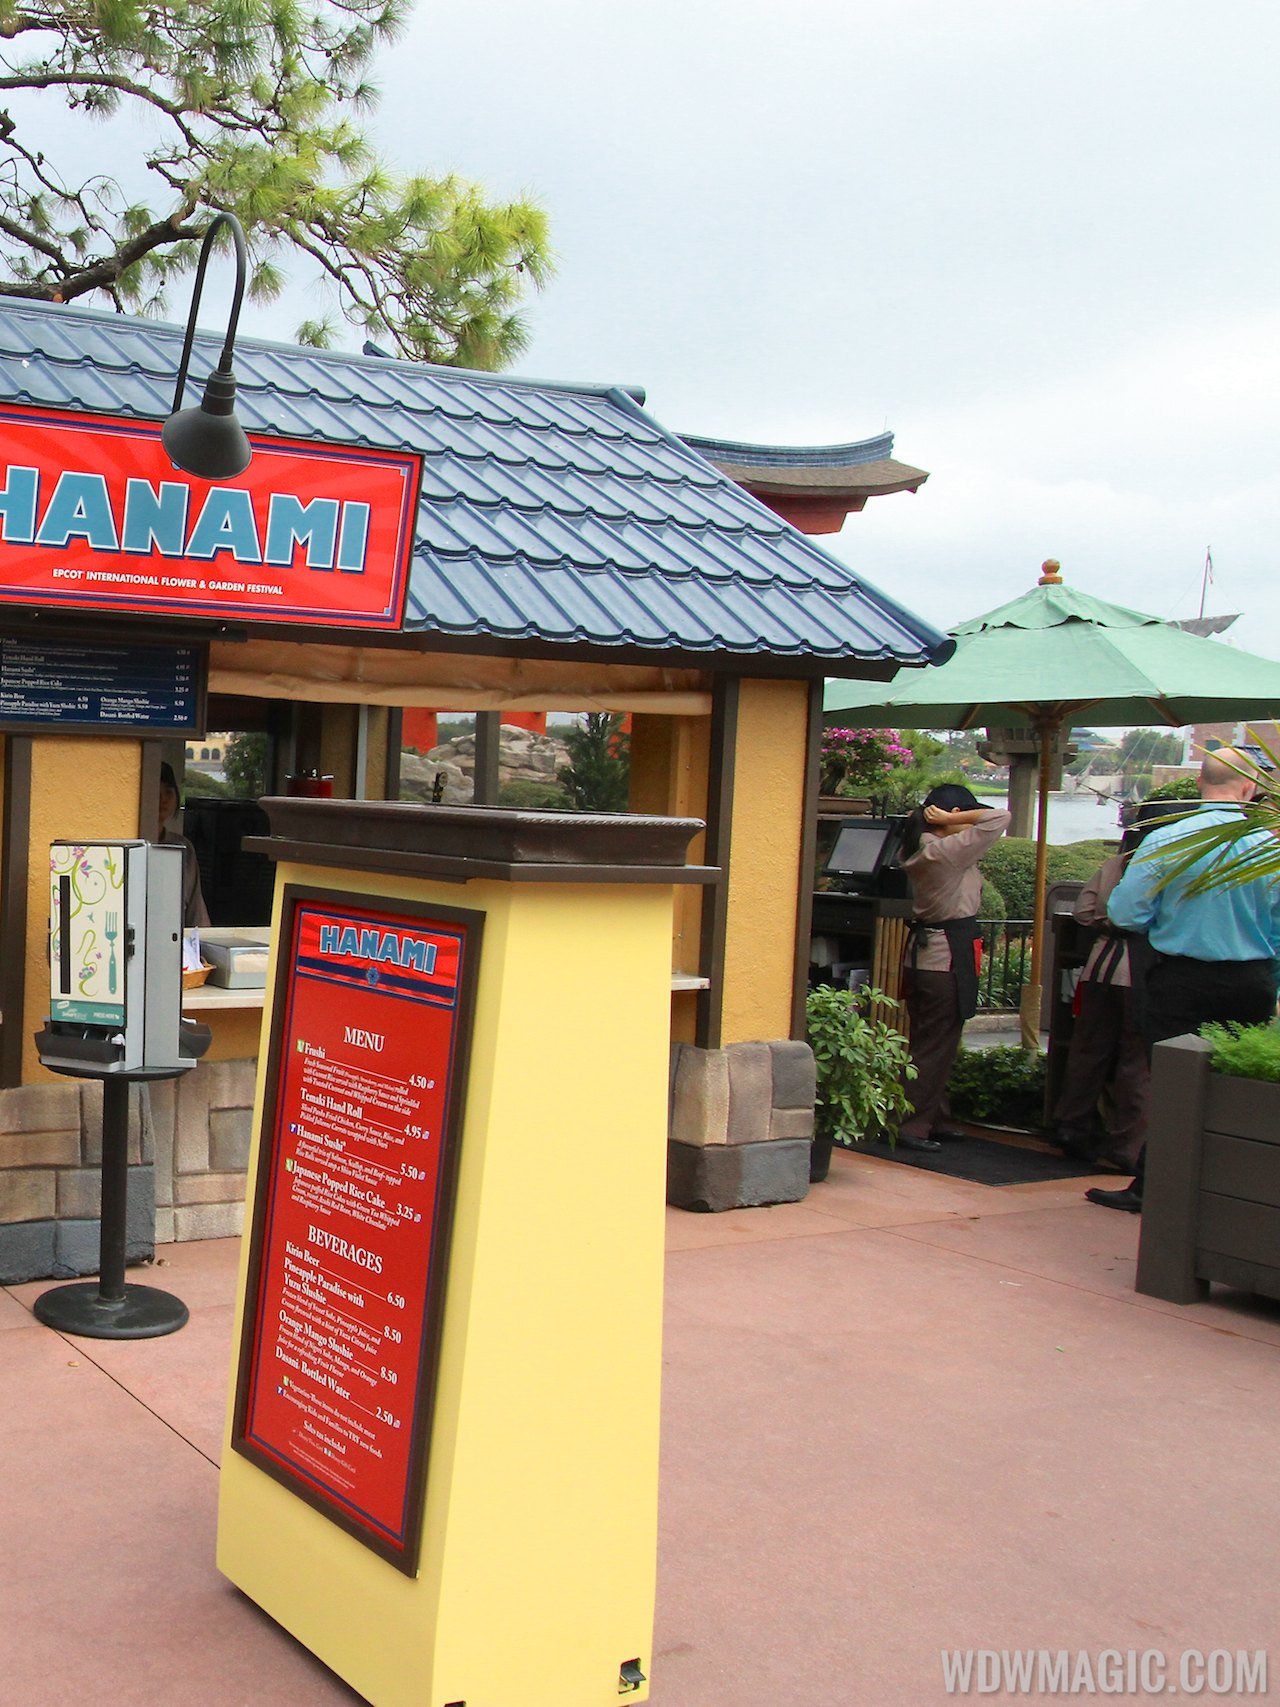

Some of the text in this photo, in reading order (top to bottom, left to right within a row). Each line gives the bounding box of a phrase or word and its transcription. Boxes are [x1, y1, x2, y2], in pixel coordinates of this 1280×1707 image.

[52, 568, 283, 595] EPCOT INTERNATIONAL FLOWER & GARDEN FESTIVAL
[320, 925, 437, 975] HANAMI
[305, 1043, 326, 1059] Frushi
[409, 1074, 427, 1089] 4.50
[344, 1026, 385, 1053] MENU
[300, 1087, 422, 1140] Temaki Hand Roll 4.95
[297, 1124, 324, 1144] Hanami
[400, 1164, 418, 1181] 5.50
[292, 1160, 413, 1221] Japanese Popped Rice Cake 3.25
[286, 1241, 405, 1310] Kirin Beer 6.50
[308, 1224, 383, 1275] BEVERAGES
[284, 1257, 365, 1308] Pineapple Paradise with
[284, 1273, 402, 1345] Yuzu Slushie 8.50
[279, 1309, 398, 1386] Orange Mango Slushie 8.50
[301, 1362, 327, 1387] Bottled
[327, 1377, 350, 1402] Water
[376, 1406, 393, 1426] 2.50
